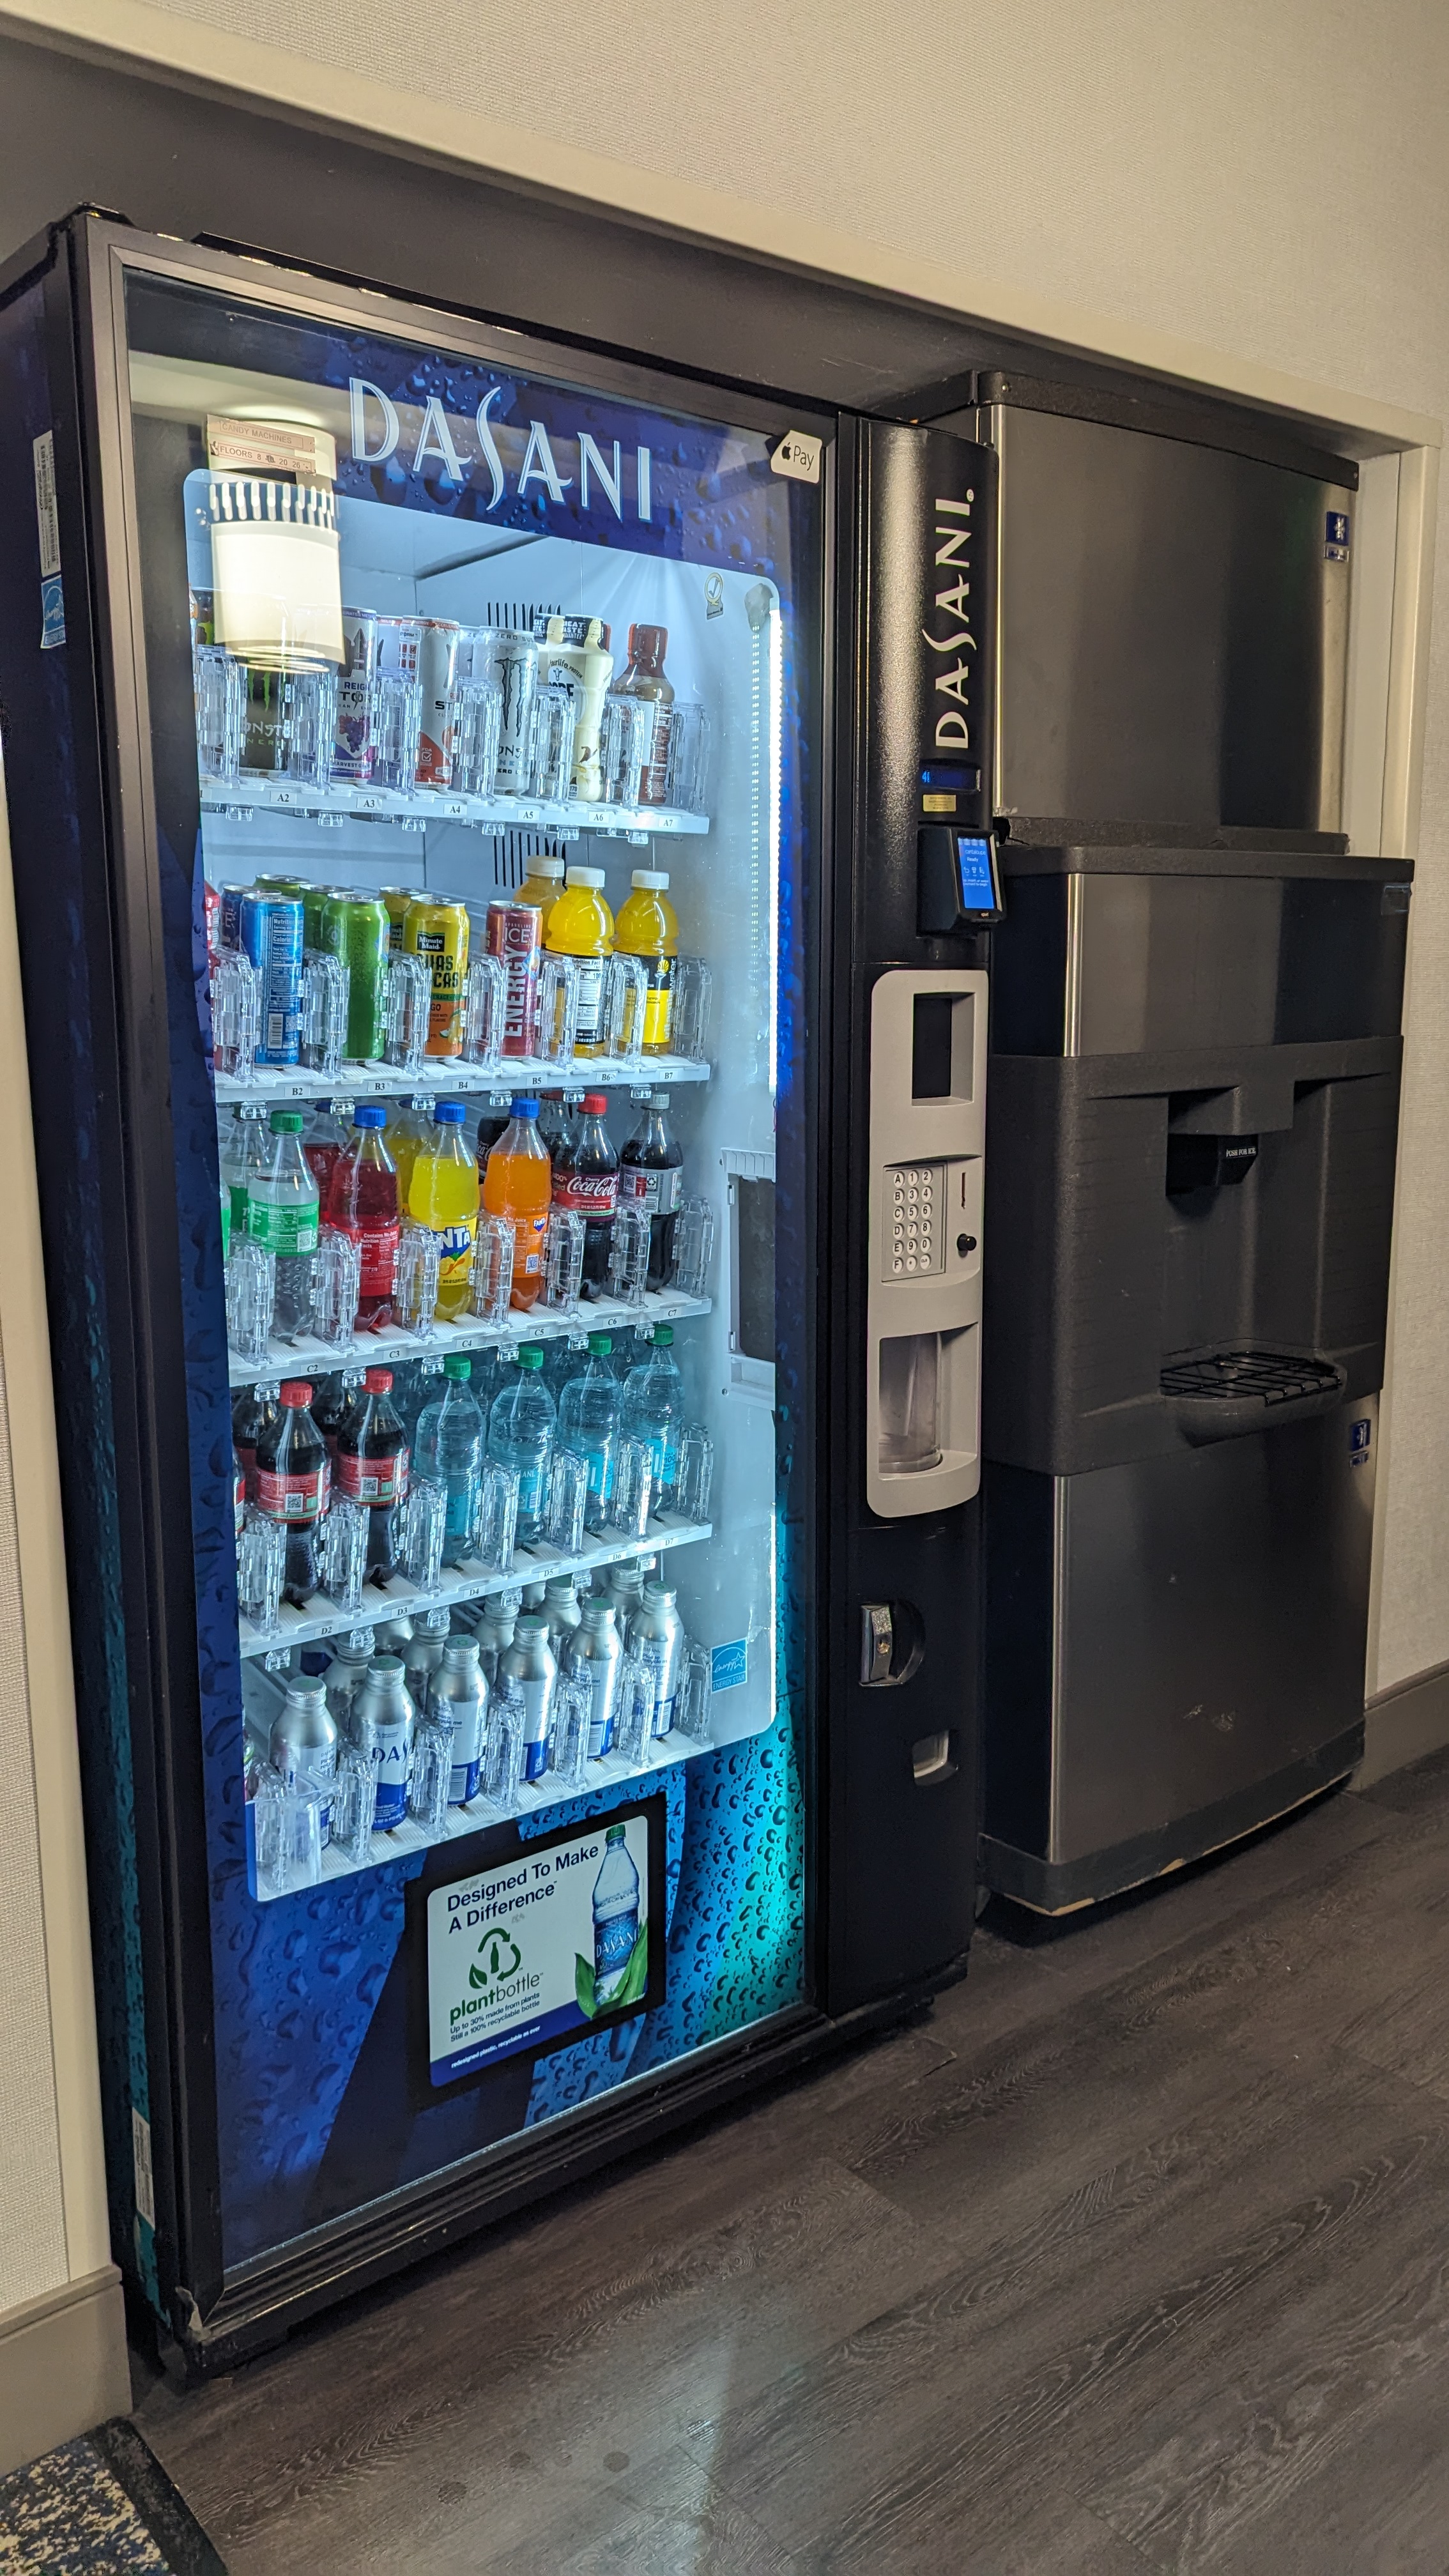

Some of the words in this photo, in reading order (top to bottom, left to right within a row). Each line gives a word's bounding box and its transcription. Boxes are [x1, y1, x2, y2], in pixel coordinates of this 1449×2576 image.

[222, 423, 249, 436] CANDY
[252, 429, 292, 444] MACHINES
[220, 446, 252, 459] FLOORS
[349, 377, 651, 521] DASANI
[793, 445, 814, 471] Pay
[922, 498, 977, 749] DASANI
[569, 666, 583, 679] PROTEIN
[339, 691, 372, 702] TOR
[277, 793, 289, 802] A2
[363, 799, 375, 808] A3
[449, 805, 461, 814] A4
[523, 811, 533, 820] A5
[663, 818, 673, 826] A7
[505, 928, 530, 943] ICE
[505, 945, 528, 1037] ENERGY
[374, 1082, 386, 1091] B3
[458, 1080, 468, 1089] B4
[532, 1077, 542, 1085] B5
[292, 1087, 303, 1096] B2
[895, 1174, 901, 1184] A
[910, 1172, 914, 1182] 1
[923, 1171, 928, 1181] 2
[567, 1176, 617, 1197] Coca-Cola
[895, 1192, 900, 1200] B
[909, 1190, 914, 1199] 3
[923, 1188, 928, 1198] 4
[894, 1208, 900, 1218] C
[908, 1207, 914, 1216] 5
[923, 1206, 928, 1215] 6
[894, 1226, 900, 1235] D
[908, 1224, 914, 1234] 7
[923, 1222, 928, 1232] 8
[437, 1227, 471, 1248] NTA
[894, 1243, 900, 1252] E
[908, 1241, 914, 1250] 9
[922, 1239, 927, 1249] 0
[894, 1260, 899, 1269] F
[668, 1308, 677, 1317] C7
[608, 1317, 617, 1326] C6
[534, 1328, 544, 1337] C5
[389, 1350, 400, 1358] C3
[307, 1364, 318, 1373] C2
[470, 1588, 480, 1596] D4
[397, 1607, 408, 1616] D3
[320, 1626, 332, 1635] D2
[713, 1677, 732, 1690] ENERGY
[733, 1675, 745, 1683] STAR
[447, 1867, 527, 1912] Designed
[532, 1862, 550, 1879] To
[556, 1846, 599, 1871] Make
[448, 1917, 462, 1935] A
[467, 1884, 555, 1927] Difference
[596, 1928, 637, 1959] DASANI
[450, 1973, 540, 2026] plantbottle
[470, 2015, 484, 2025] 30%
[486, 2008, 503, 2020] made
[505, 2001, 519, 2012] from
[521, 1992, 540, 2005] plants
[450, 2032, 463, 2042] Still
[471, 2023, 486, 2034] 100%
[487, 2008, 520, 2027] recyclable
[521, 2000, 540, 2012] bottle
[451, 2051, 479, 2069] redesigned
[480, 2044, 498, 2057] plastic,
[498, 2033, 523, 2048] recyclable
[530, 2025, 540, 2034] ever
